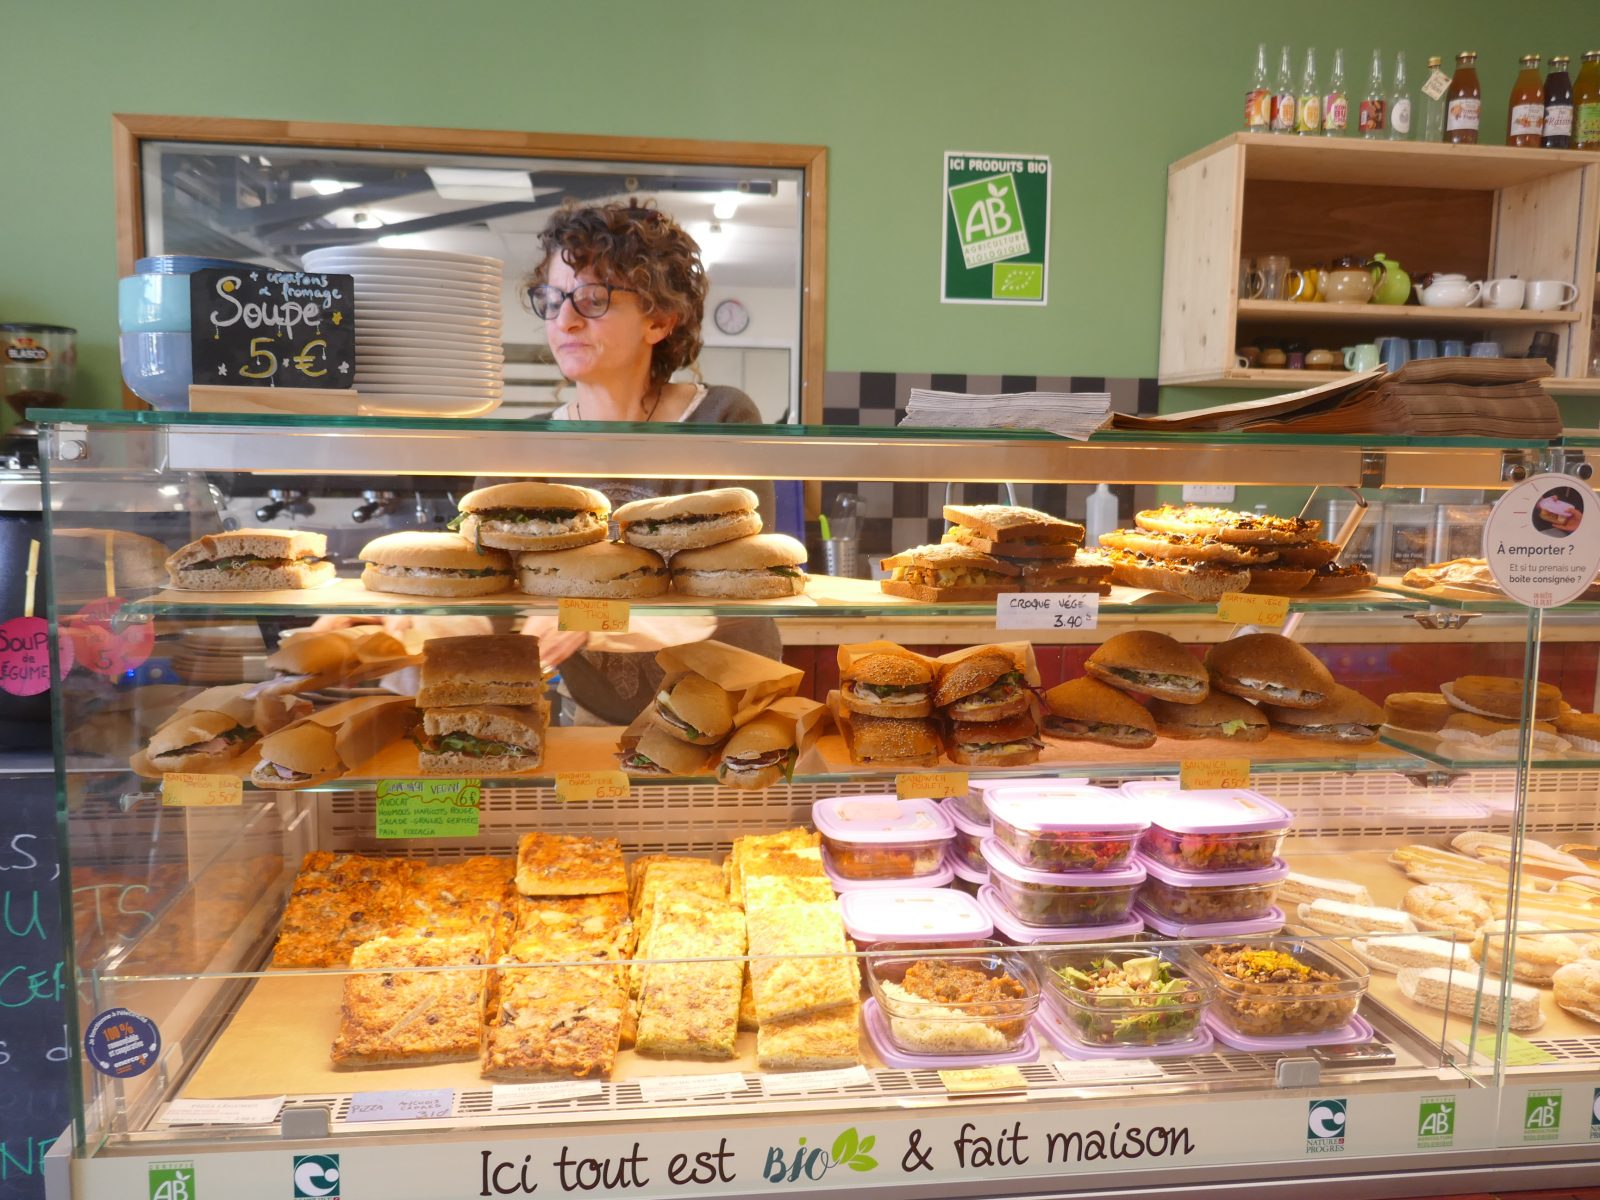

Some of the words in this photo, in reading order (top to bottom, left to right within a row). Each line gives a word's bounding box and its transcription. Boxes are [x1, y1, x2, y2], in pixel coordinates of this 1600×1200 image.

[950, 158, 964, 170] ICI
[969, 159, 1023, 173] PRODUITS
[1028, 162, 1047, 174] BIO
[966, 197, 1012, 242] AB
[964, 232, 1025, 254] AGRICULTURE
[966, 243, 1027, 265] BIOLOGIQUE
[210, 275, 320, 340] Soupe
[1508, 545, 1566, 558] emporter
[1510, 564, 1518, 572] Et
[1520, 564, 1527, 572] si
[1528, 564, 1537, 572] tu
[1538, 564, 1569, 574] prenais
[1532, 575, 1576, 586] consignée
[1009, 598, 1050, 610] CROQUE
[22, 654, 36, 664] de
[900, 774, 946, 784] SANDWICH
[912, 782, 944, 790] POULET
[379, 798, 409, 806] AVOCAT
[352, 1104, 384, 1114] PIZZA
[1420, 1112, 1449, 1135] AB
[1526, 1106, 1555, 1128] AB
[1306, 1138, 1338, 1146] NATURE
[480, 1150, 538, 1196] Ici
[553, 1142, 650, 1191] tout
[668, 1138, 736, 1185] est
[902, 1129, 934, 1172] &
[954, 1122, 1029, 1168] fait
[1046, 1122, 1195, 1163] maison
[154, 1180, 188, 1200] AB
